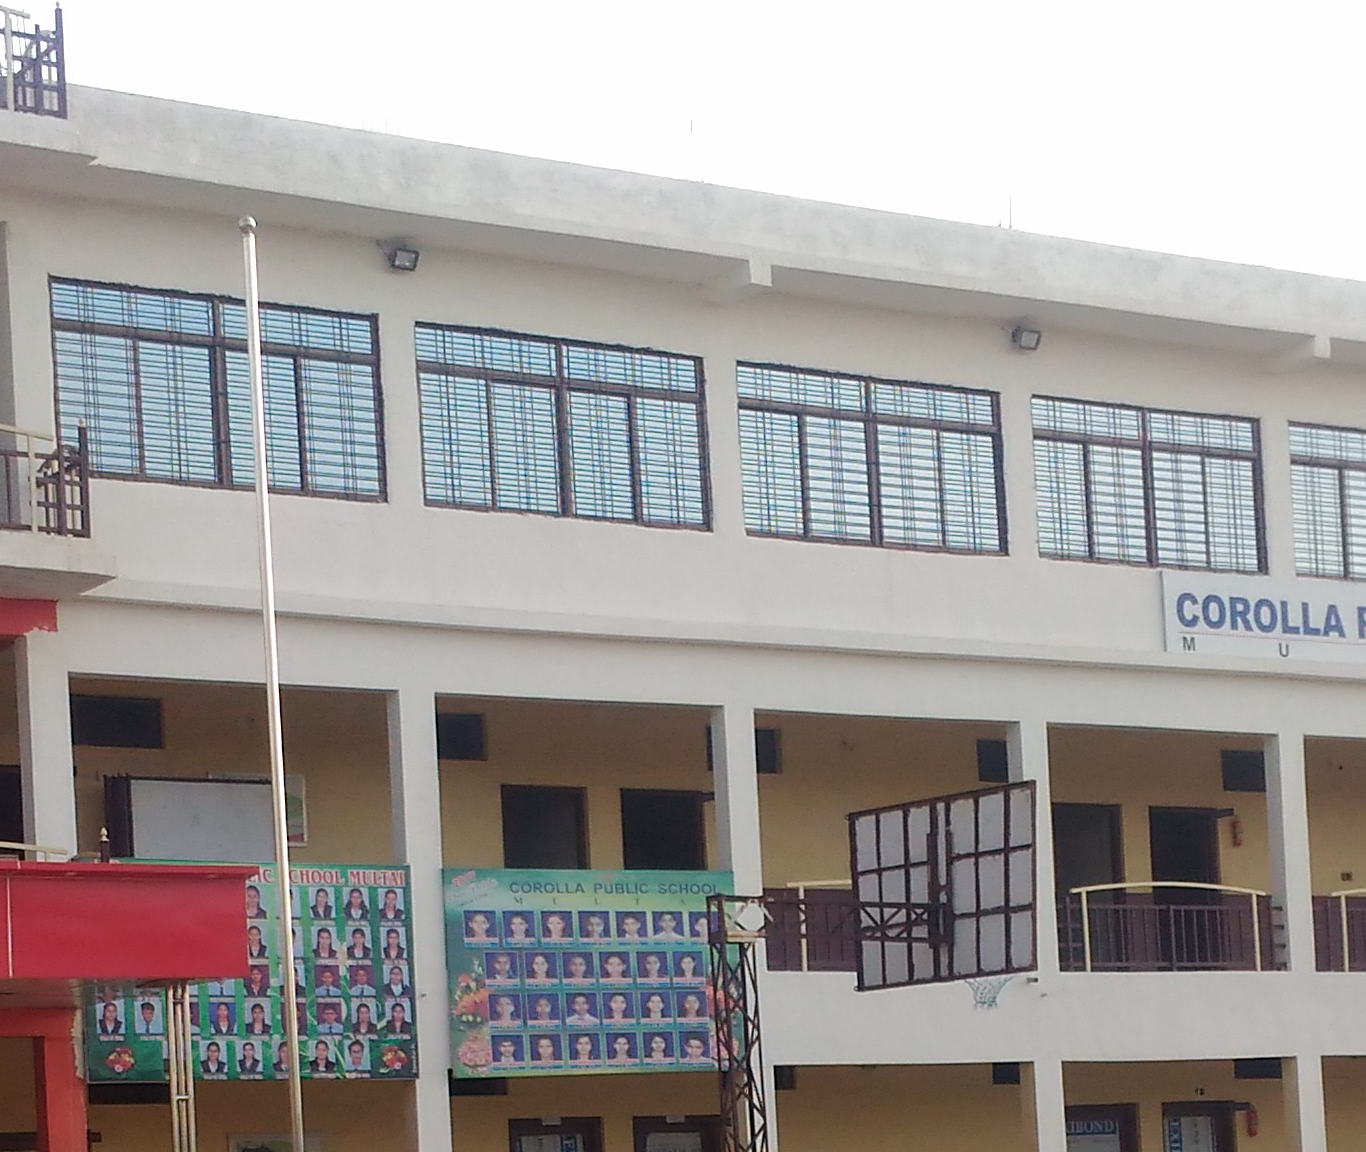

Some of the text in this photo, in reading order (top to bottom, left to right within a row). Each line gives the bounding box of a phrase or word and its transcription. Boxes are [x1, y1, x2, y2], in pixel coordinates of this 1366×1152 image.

[1176, 592, 1346, 639] COROLLA
[289, 869, 344, 884] CHOOL
[349, 870, 405, 886] MULTAI
[509, 882, 585, 894] COROLLA
[594, 882, 649, 895] PUBLIC
[658, 882, 718, 895] SCHOOL
